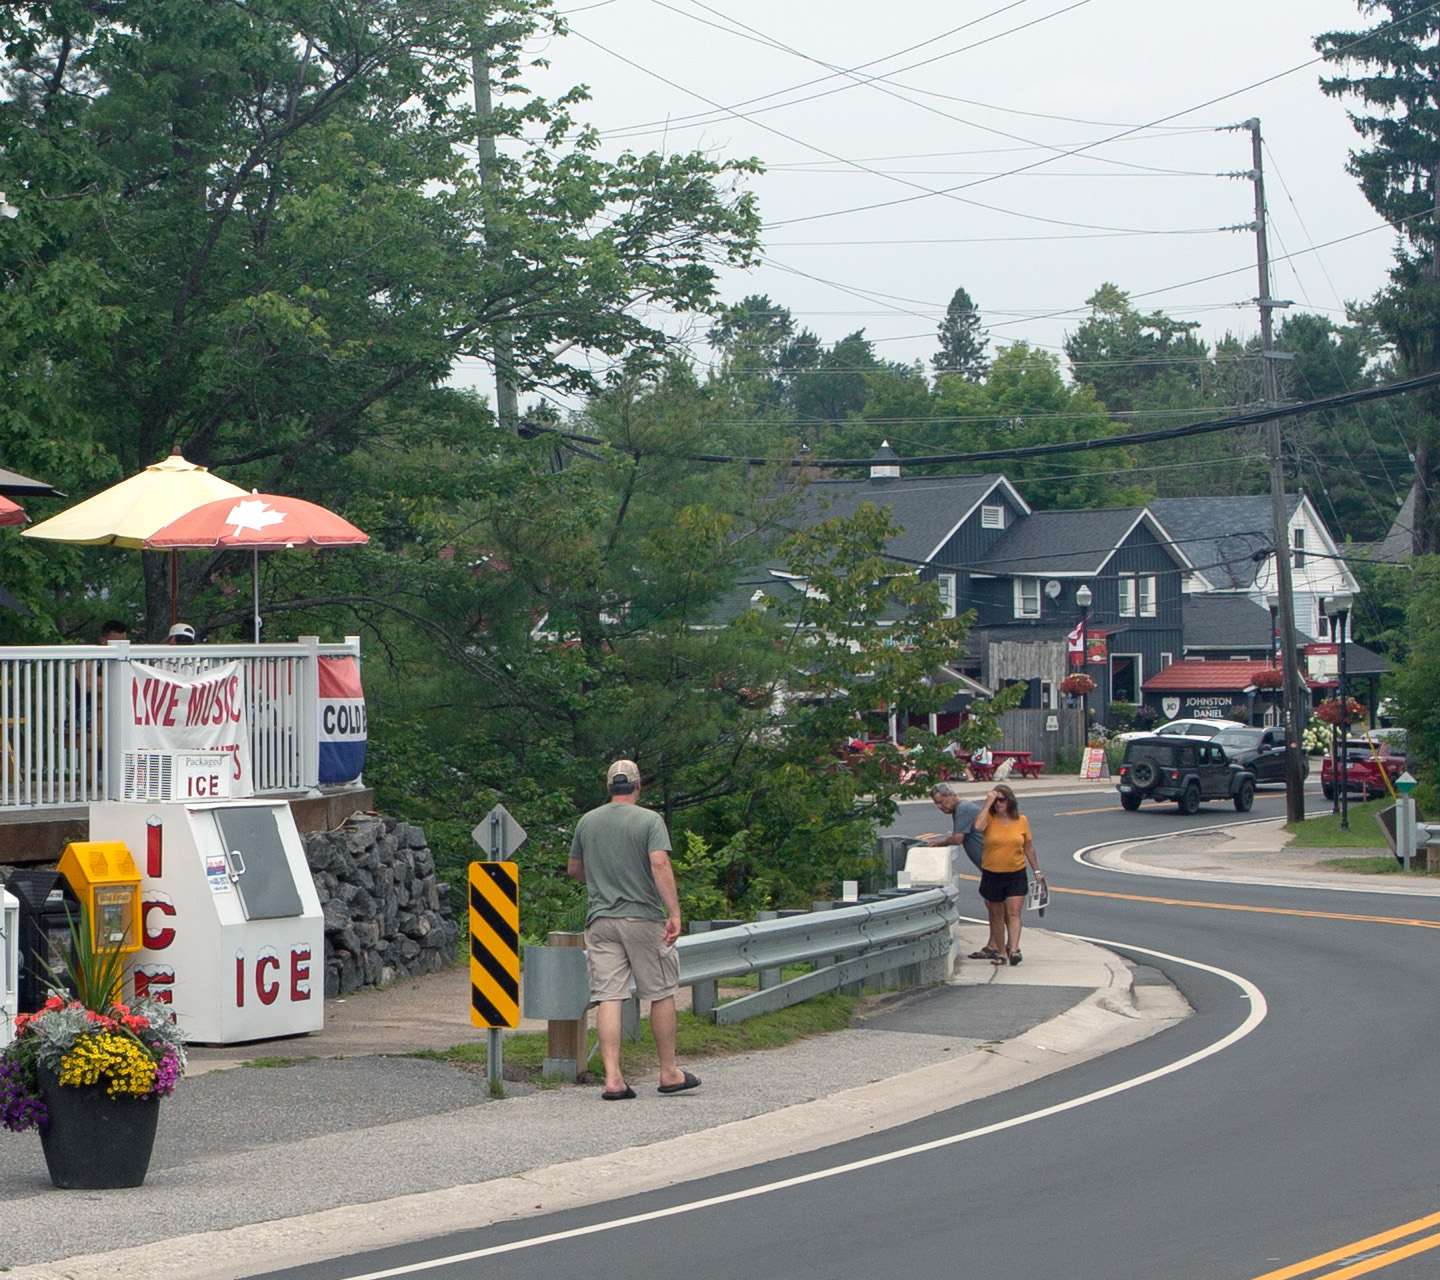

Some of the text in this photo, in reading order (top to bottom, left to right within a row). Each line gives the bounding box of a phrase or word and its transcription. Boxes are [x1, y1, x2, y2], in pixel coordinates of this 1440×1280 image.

[131, 674, 242, 728] LIVE MUSIC
[1185, 696, 1232, 707] JOHNSTON
[323, 704, 361, 735] COLD
[1193, 709, 1224, 718] DANIEL
[185, 756, 223, 768] Packaged
[187, 774, 220, 797] ICE
[234, 941, 313, 1008] ICE
